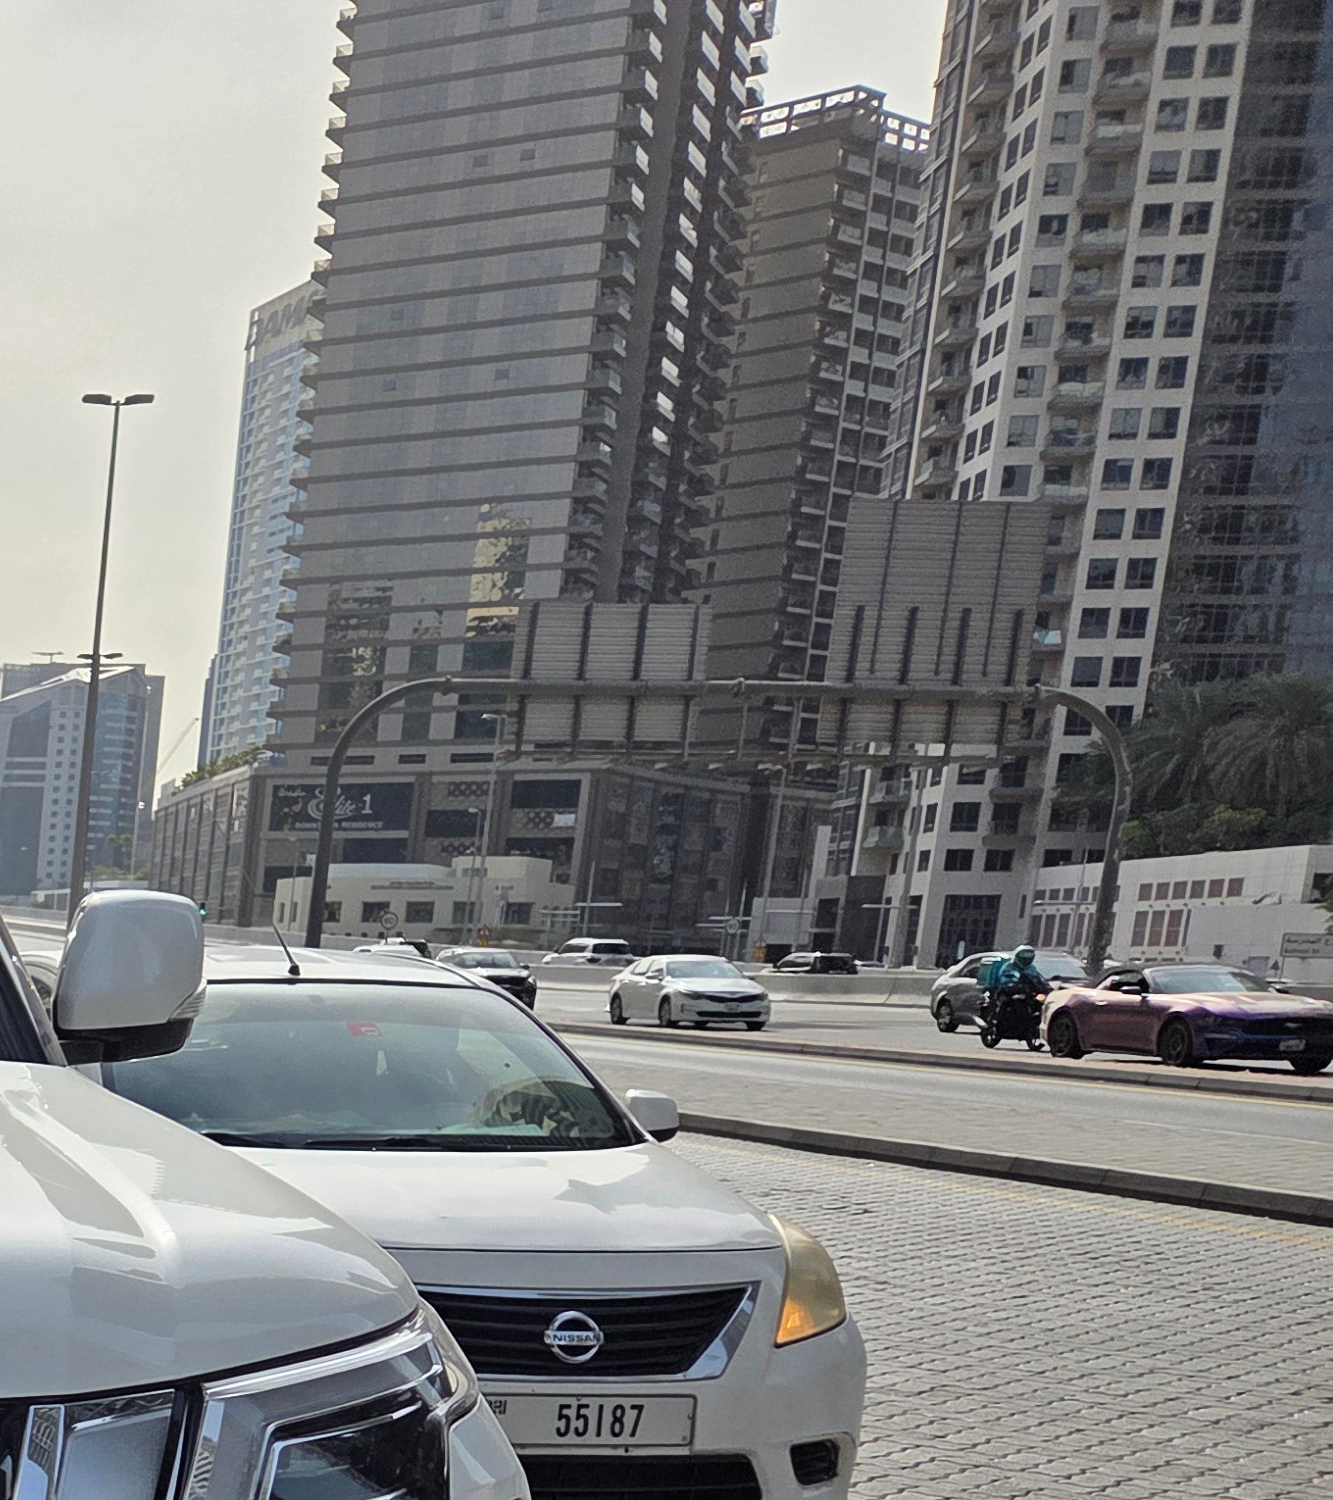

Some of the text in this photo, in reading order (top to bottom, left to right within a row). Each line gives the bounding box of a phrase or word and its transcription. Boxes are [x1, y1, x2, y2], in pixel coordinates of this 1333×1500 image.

[361, 793, 374, 814] 1
[552, 1333, 601, 1343] NISSAN
[555, 1403, 645, 1438] 55187
